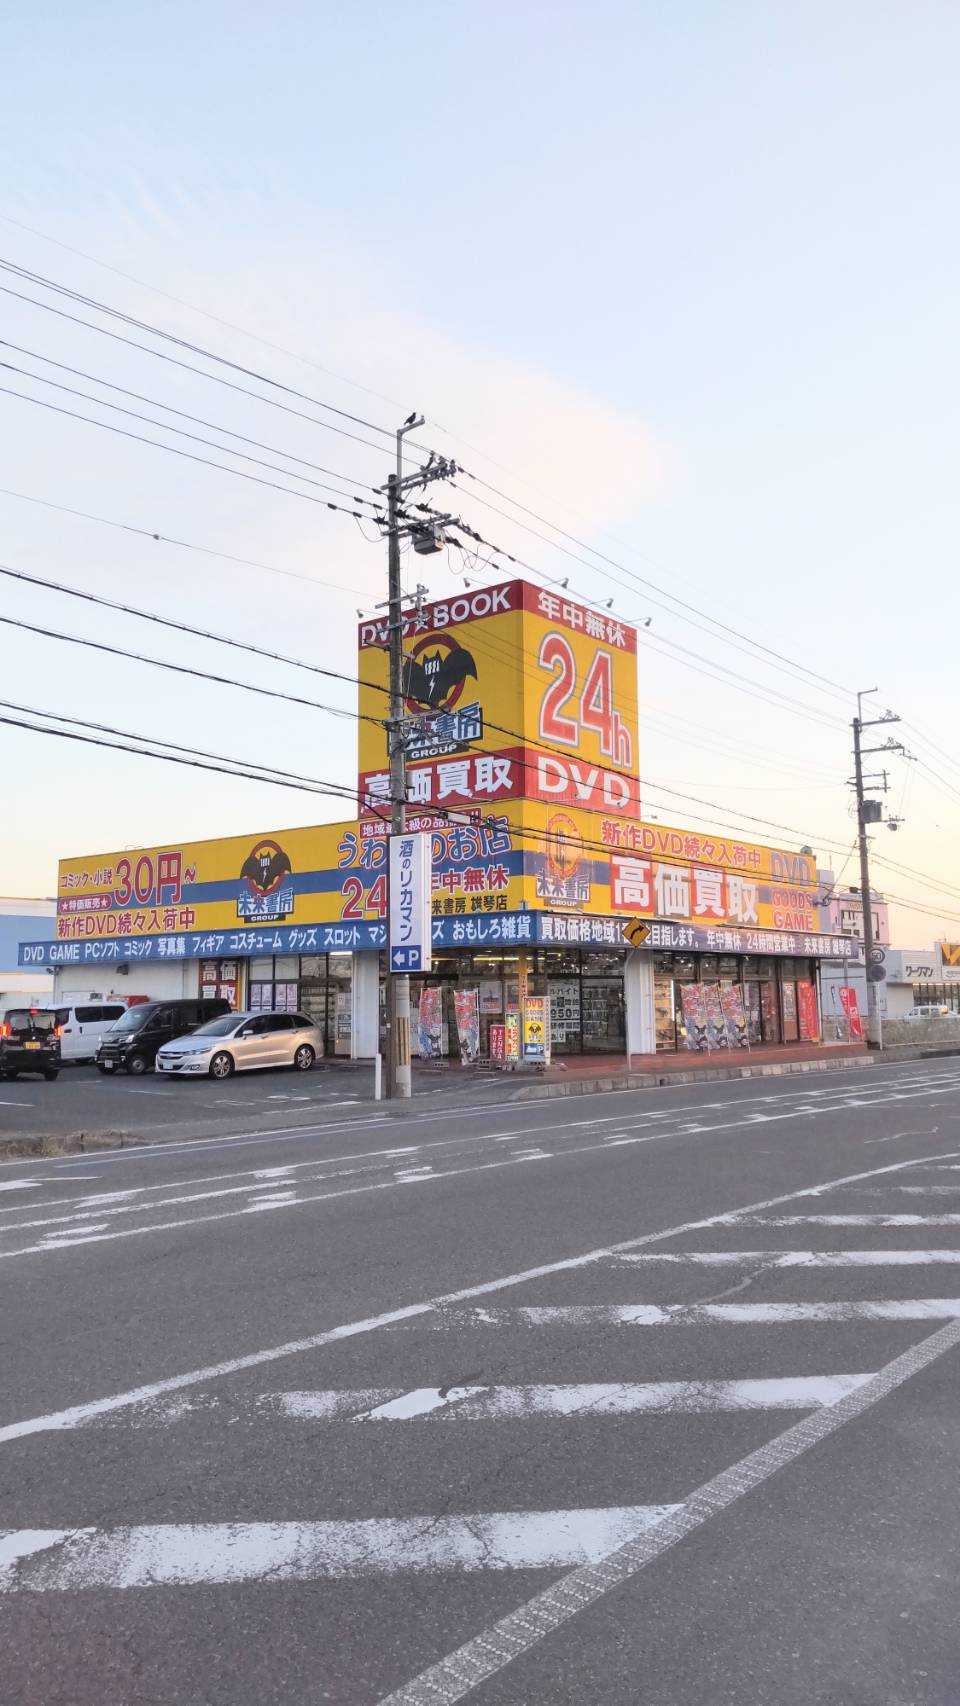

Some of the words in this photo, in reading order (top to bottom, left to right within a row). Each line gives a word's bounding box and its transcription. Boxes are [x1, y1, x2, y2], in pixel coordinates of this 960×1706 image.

[538, 591, 627, 647] 年中無休
[539, 630, 633, 770] 24h
[537, 756, 631, 808] DVD
[338, 817, 513, 869] うわのお店
[601, 820, 761, 868] 新作DVD続々入荷中
[60, 868, 113, 889] コミック・小説
[399, 839, 415, 942] 酒のリカマン
[611, 853, 760, 925] 高価買取
[23, 947, 45, 962] DVD
[50, 944, 80, 960] GAME
[85, 941, 119, 958] PCソフト
[124, 940, 153, 956] コミック
[157, 937, 186, 956] 写真集
[230, 932, 283, 950] コスチューム
[288, 928, 318, 948] グッズ
[324, 926, 361, 946] スロット
[452, 915, 531, 940] おもしろ雑貨
[58, 907, 195, 938] 新作DVD続々入荷中
[408, 950, 419, 967] P
[905, 965, 933, 978] ワークマン
